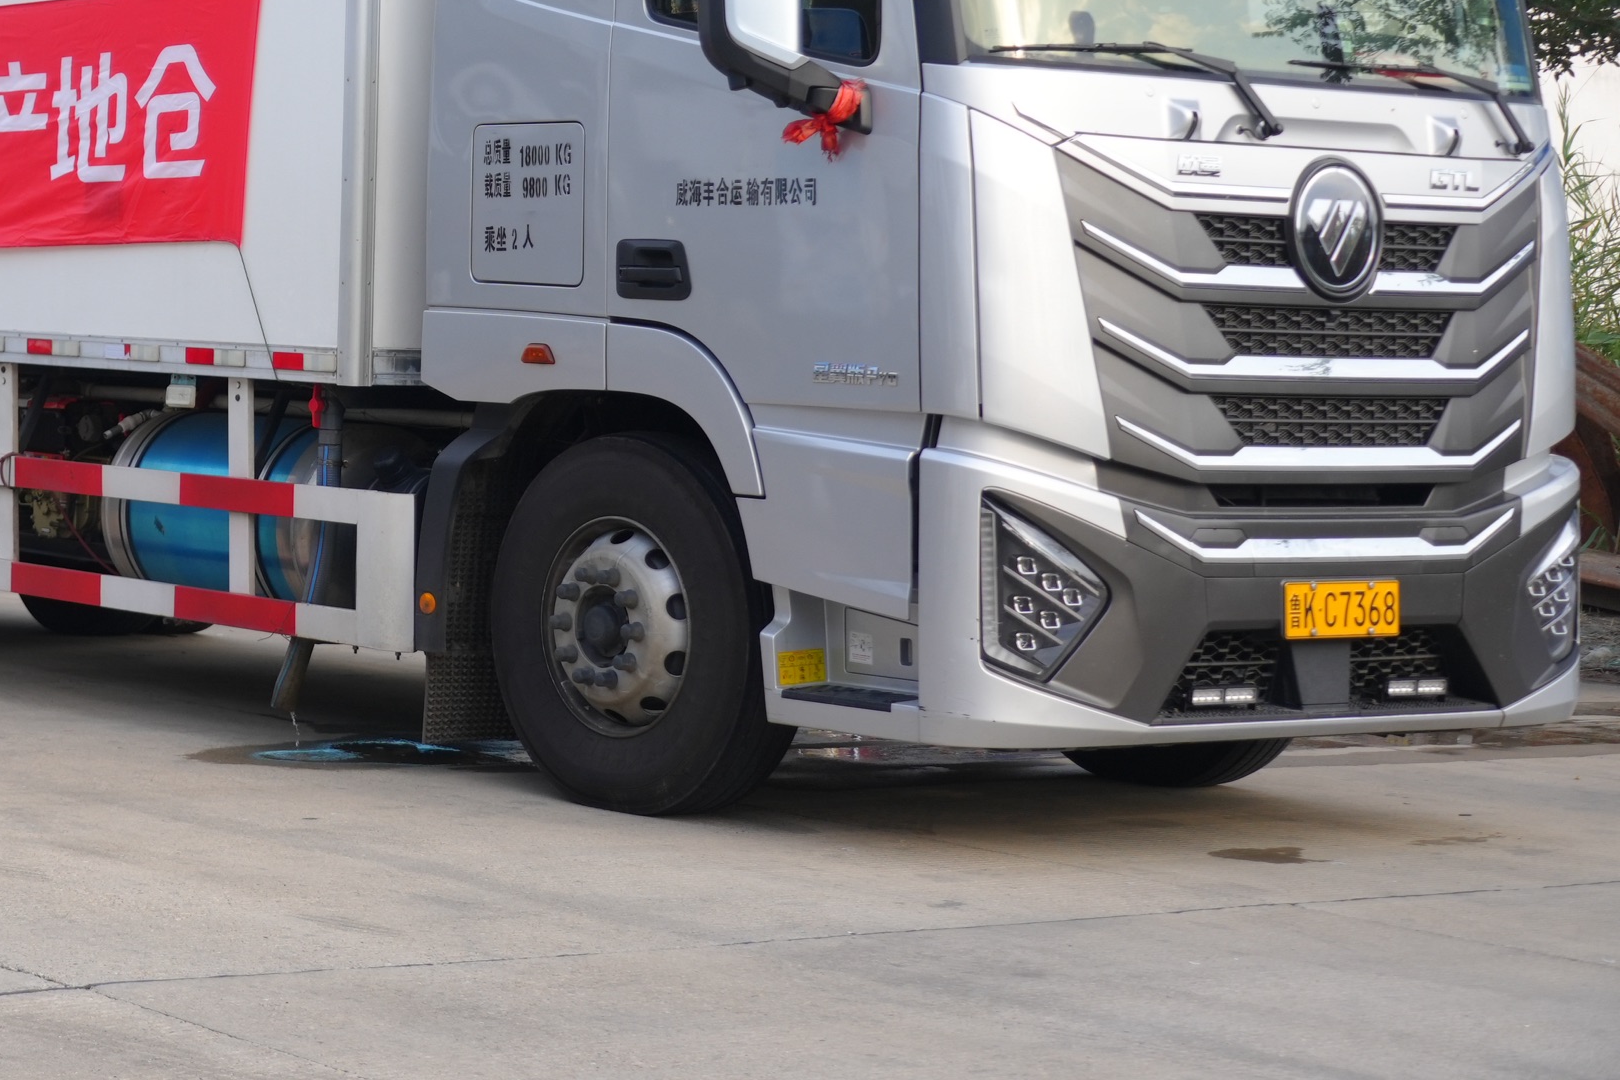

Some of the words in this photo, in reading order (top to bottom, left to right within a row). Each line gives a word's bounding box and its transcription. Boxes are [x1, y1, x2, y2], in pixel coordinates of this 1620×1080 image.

[484, 138, 511, 166] 总质量
[520, 145, 550, 168] 18000
[555, 143, 572, 166] KG
[485, 172, 512, 198] 载质量
[523, 177, 548, 198] 9800
[554, 174, 571, 196] KG
[485, 226, 506, 253] 乘坐
[512, 228, 518, 250] 2
[522, 224, 534, 249] 人
